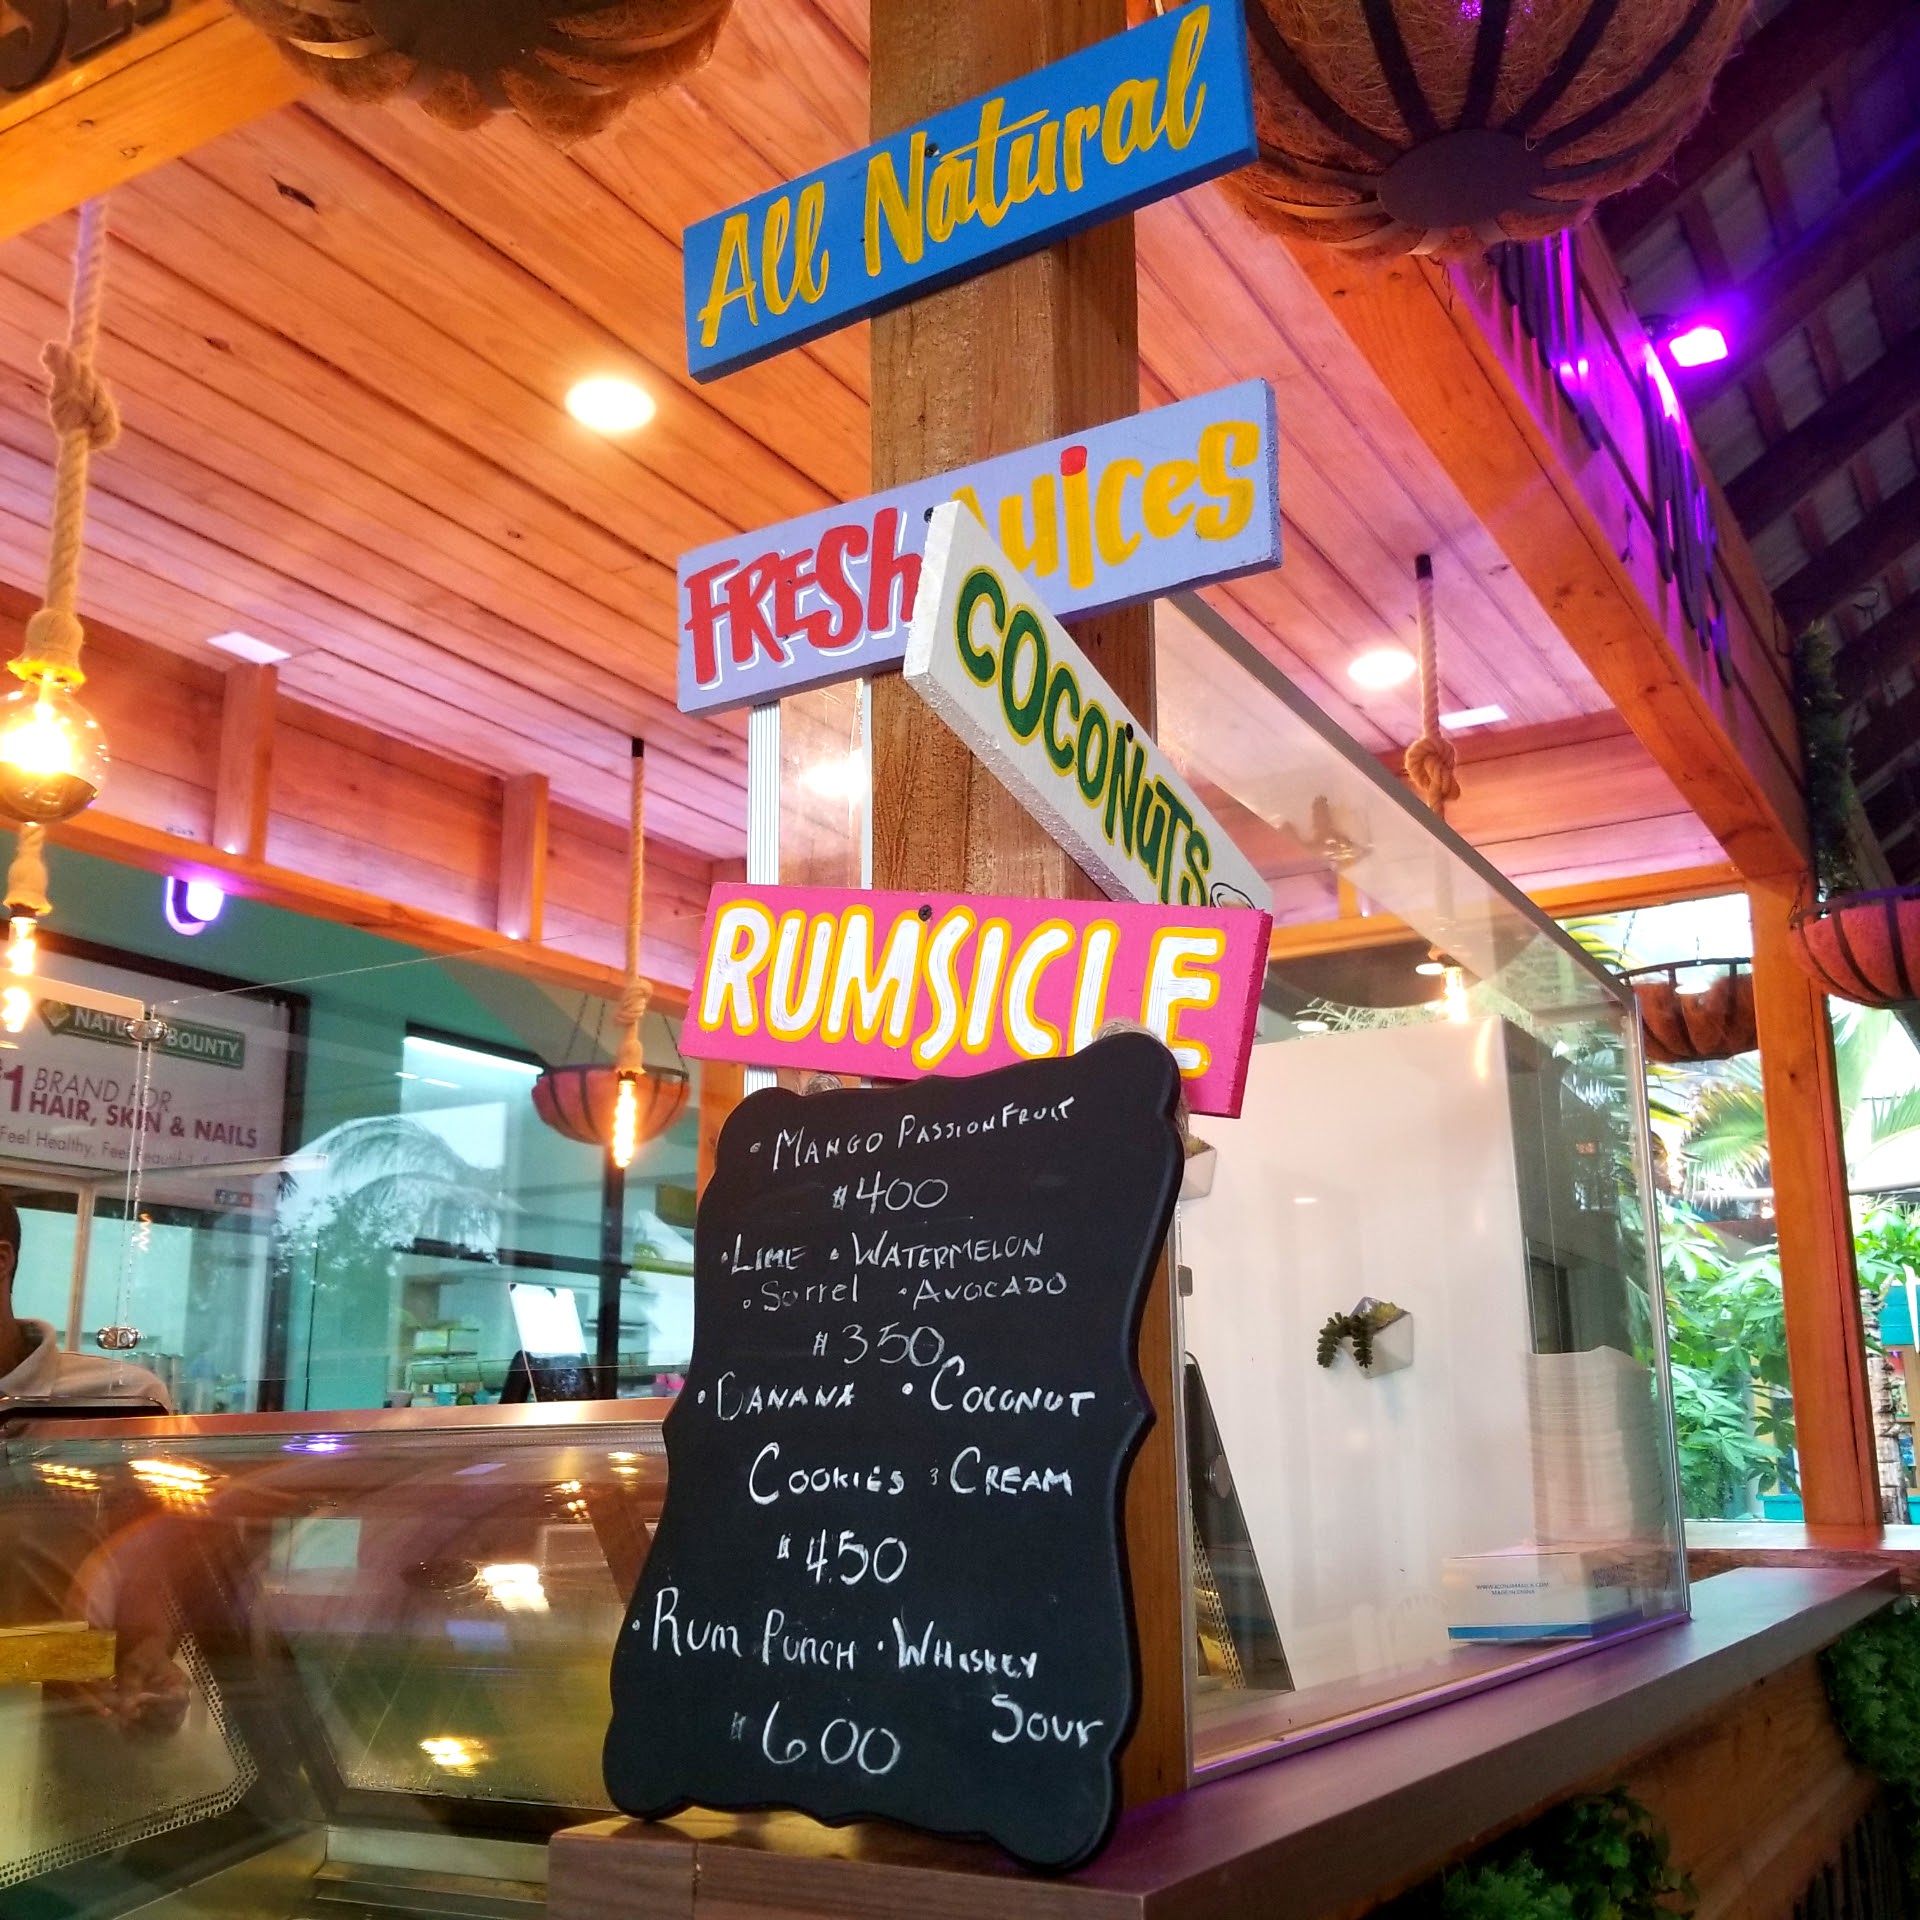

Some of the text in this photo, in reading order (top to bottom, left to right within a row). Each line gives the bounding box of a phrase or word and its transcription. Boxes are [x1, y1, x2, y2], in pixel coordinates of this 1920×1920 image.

[698, 5, 1211, 348] All Natural
[948, 420, 1261, 591] uices
[166, 1027, 241, 1060] BOUNTY
[0, 1060, 24, 1113] 1
[34, 1067, 173, 1113] BRAND FOR
[0, 1125, 30, 1145] Feel
[29, 1091, 258, 1149] HAIR, SKIN & NAILS
[773, 1126, 884, 1172] MANGO
[731, 1229, 1044, 1273] LIME WATERMELON
[760, 1271, 1068, 1312] Sorrel AVOCADO
[930, 1355, 1096, 1417] COCONUT
[950, 1446, 1074, 1497] CREAM
